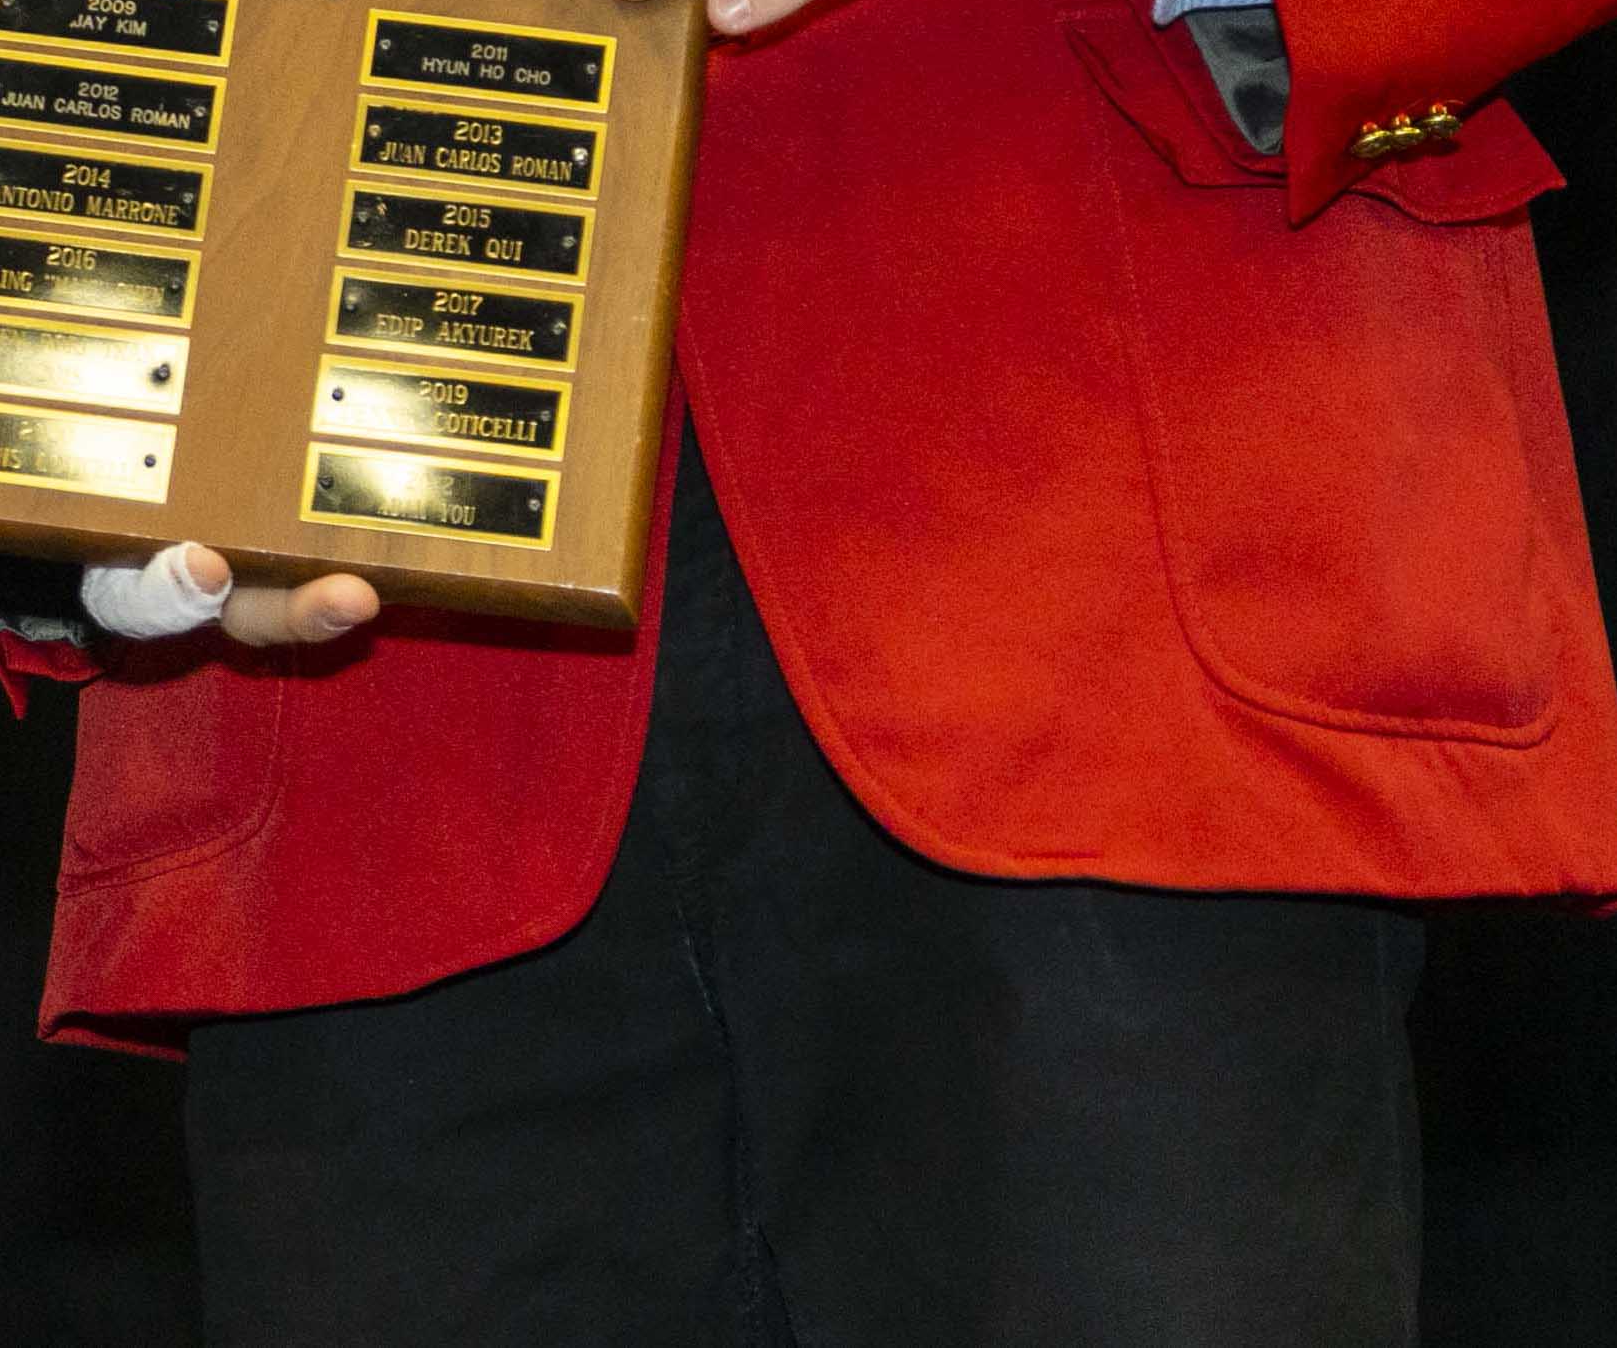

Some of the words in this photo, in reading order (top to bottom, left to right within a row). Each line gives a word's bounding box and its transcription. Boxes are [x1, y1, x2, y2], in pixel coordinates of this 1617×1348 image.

[70, 14, 108, 31] JAY
[116, 18, 148, 37] KIM
[471, 43, 508, 60] 2011
[421, 57, 470, 77] HYUN
[480, 66, 504, 81] HO
[515, 68, 551, 86] CHO
[77, 82, 119, 102] 2012
[1, 91, 46, 111] JUAN
[54, 98, 122, 122] CARLOS
[130, 106, 191, 131] ROMAN
[453, 120, 503, 145] 2013
[379, 141, 427, 165] JUAN
[436, 146, 502, 175] CARLOS
[512, 155, 573, 182] ROMAN
[62, 163, 112, 189] 2014
[86, 194, 183, 227] MARRONE
[442, 204, 492, 228] 2015
[404, 228, 473, 256] DEREK
[485, 238, 523, 262] QUI
[46, 245, 97, 271] 2016
[434, 291, 484, 316] 2017
[376, 313, 424, 338] EDIP
[436, 320, 535, 351] AKYUREK
[418, 380, 469, 405] 2019
[440, 504, 479, 526] YOU
